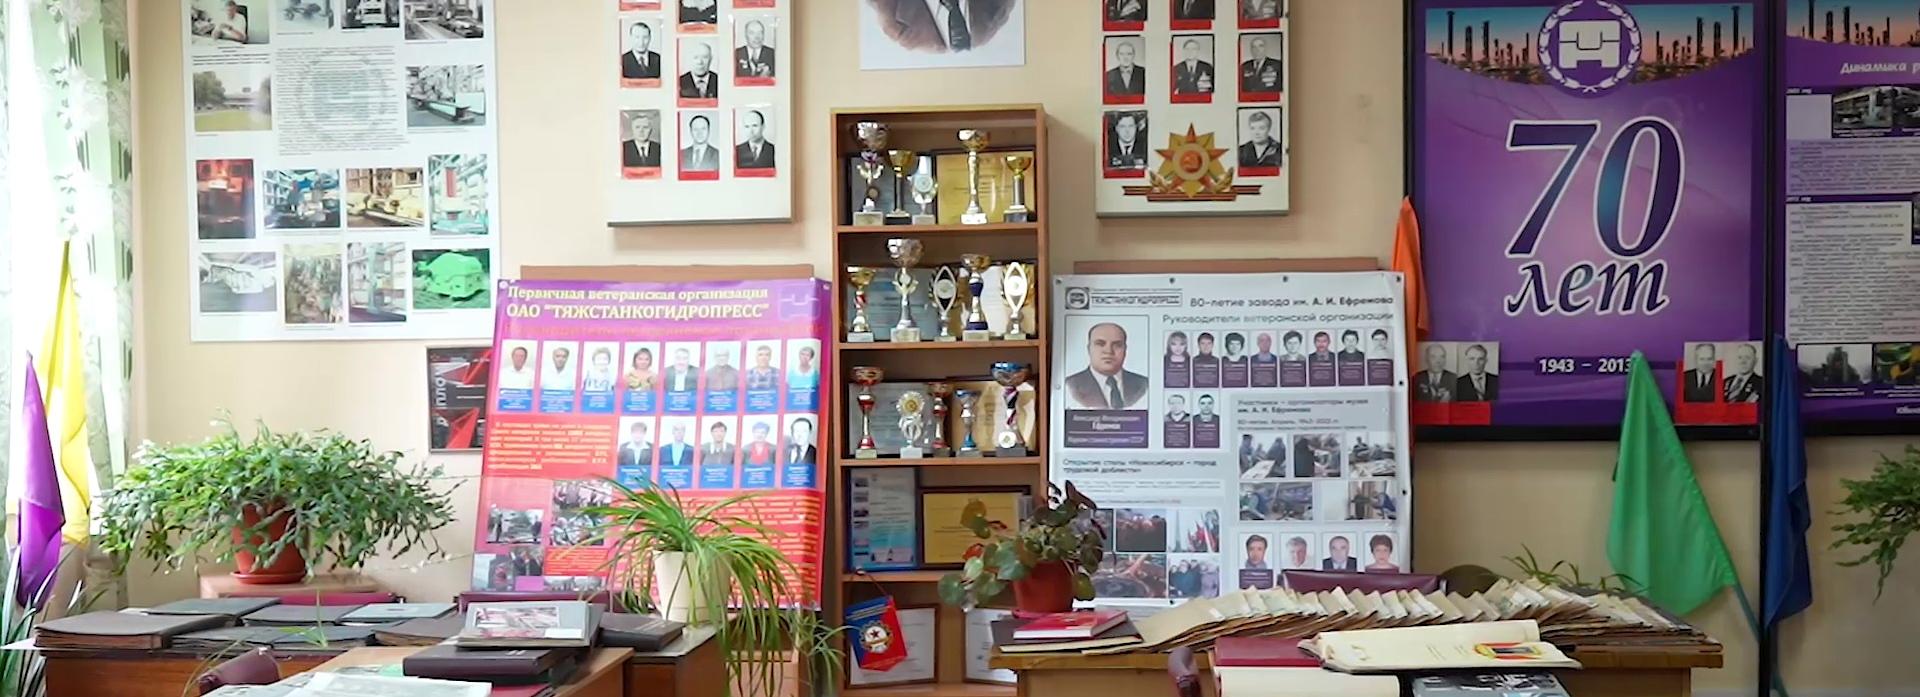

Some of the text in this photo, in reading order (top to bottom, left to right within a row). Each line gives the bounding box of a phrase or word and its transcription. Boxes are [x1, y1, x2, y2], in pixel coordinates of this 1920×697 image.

[1840, 62, 1906, 74] Динамика
[1505, 115, 1686, 260] 70
[507, 285, 769, 303] Первичная ветеранская организация
[1504, 259, 1671, 316] лет
[1190, 297, 1244, 307] 80-летие
[1248, 298, 1289, 307] завода
[1312, 297, 1323, 306] А.
[1339, 296, 1394, 306] Ефремова
[506, 303, 541, 318] ОАО
[1162, 312, 1394, 324] Руководители ветеранской организации
[1539, 358, 1575, 373] 1943
